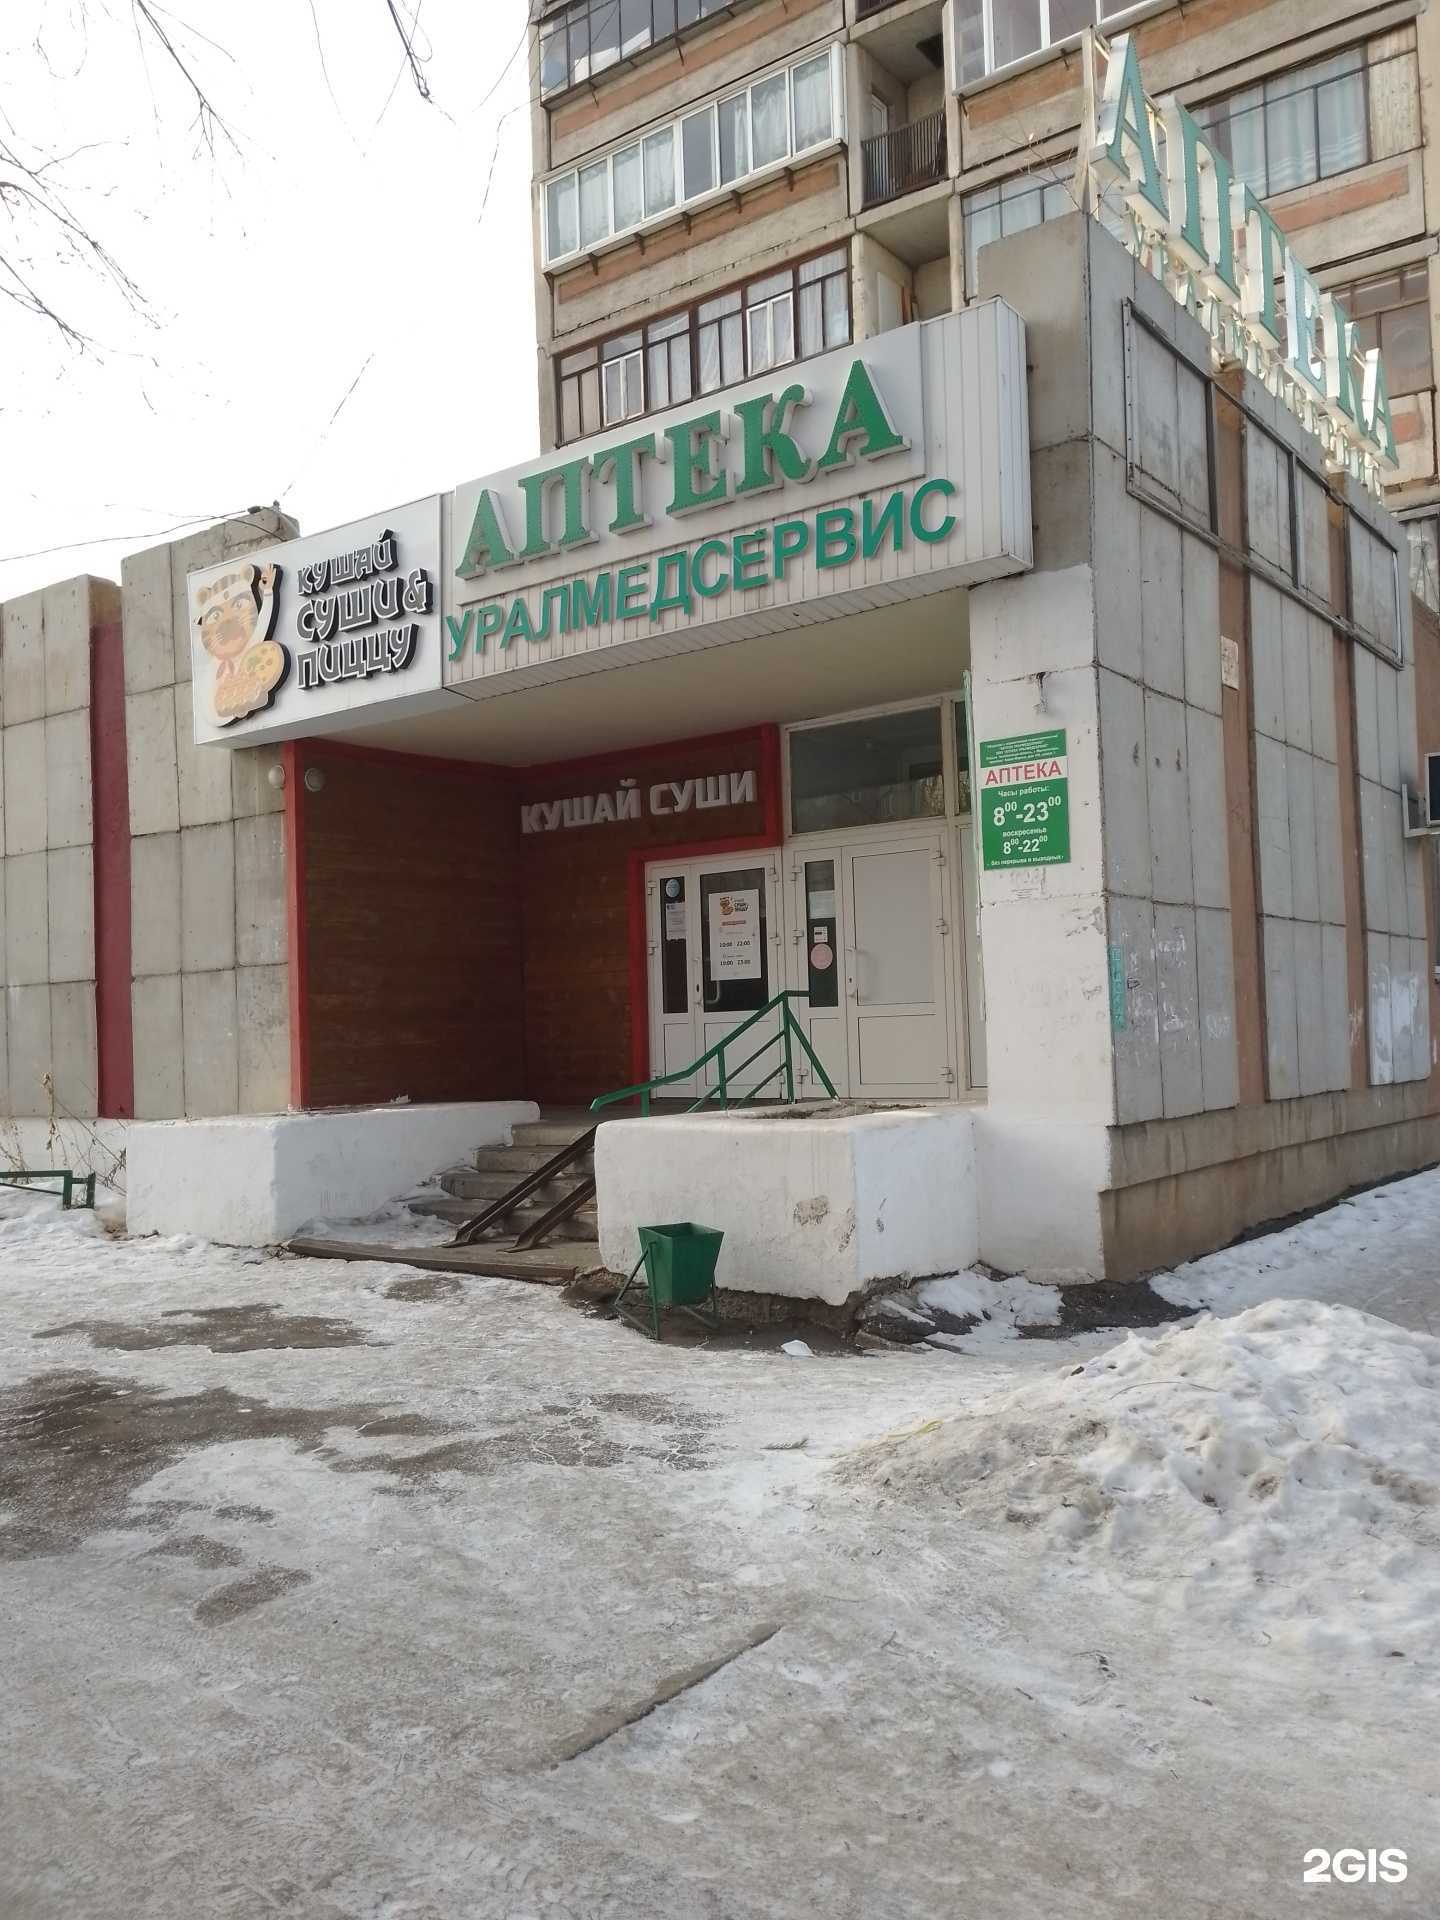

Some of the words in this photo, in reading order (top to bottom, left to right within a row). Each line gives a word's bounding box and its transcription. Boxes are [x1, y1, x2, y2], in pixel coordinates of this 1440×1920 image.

[1090, 33, 1398, 470] АПТЕКА
[455, 359, 911, 580] АПТЕКА
[298, 529, 398, 596] КУШАЙ
[445, 478, 958, 662] УРАЛМЕДСЕРВИС
[298, 623, 420, 689] ПИЦЦУ
[521, 778, 641, 833] КУШАЙ
[650, 770, 756, 815] СУШИ
[985, 760, 1062, 785] АПТЕКА
[998, 789, 1018, 798] Часы
